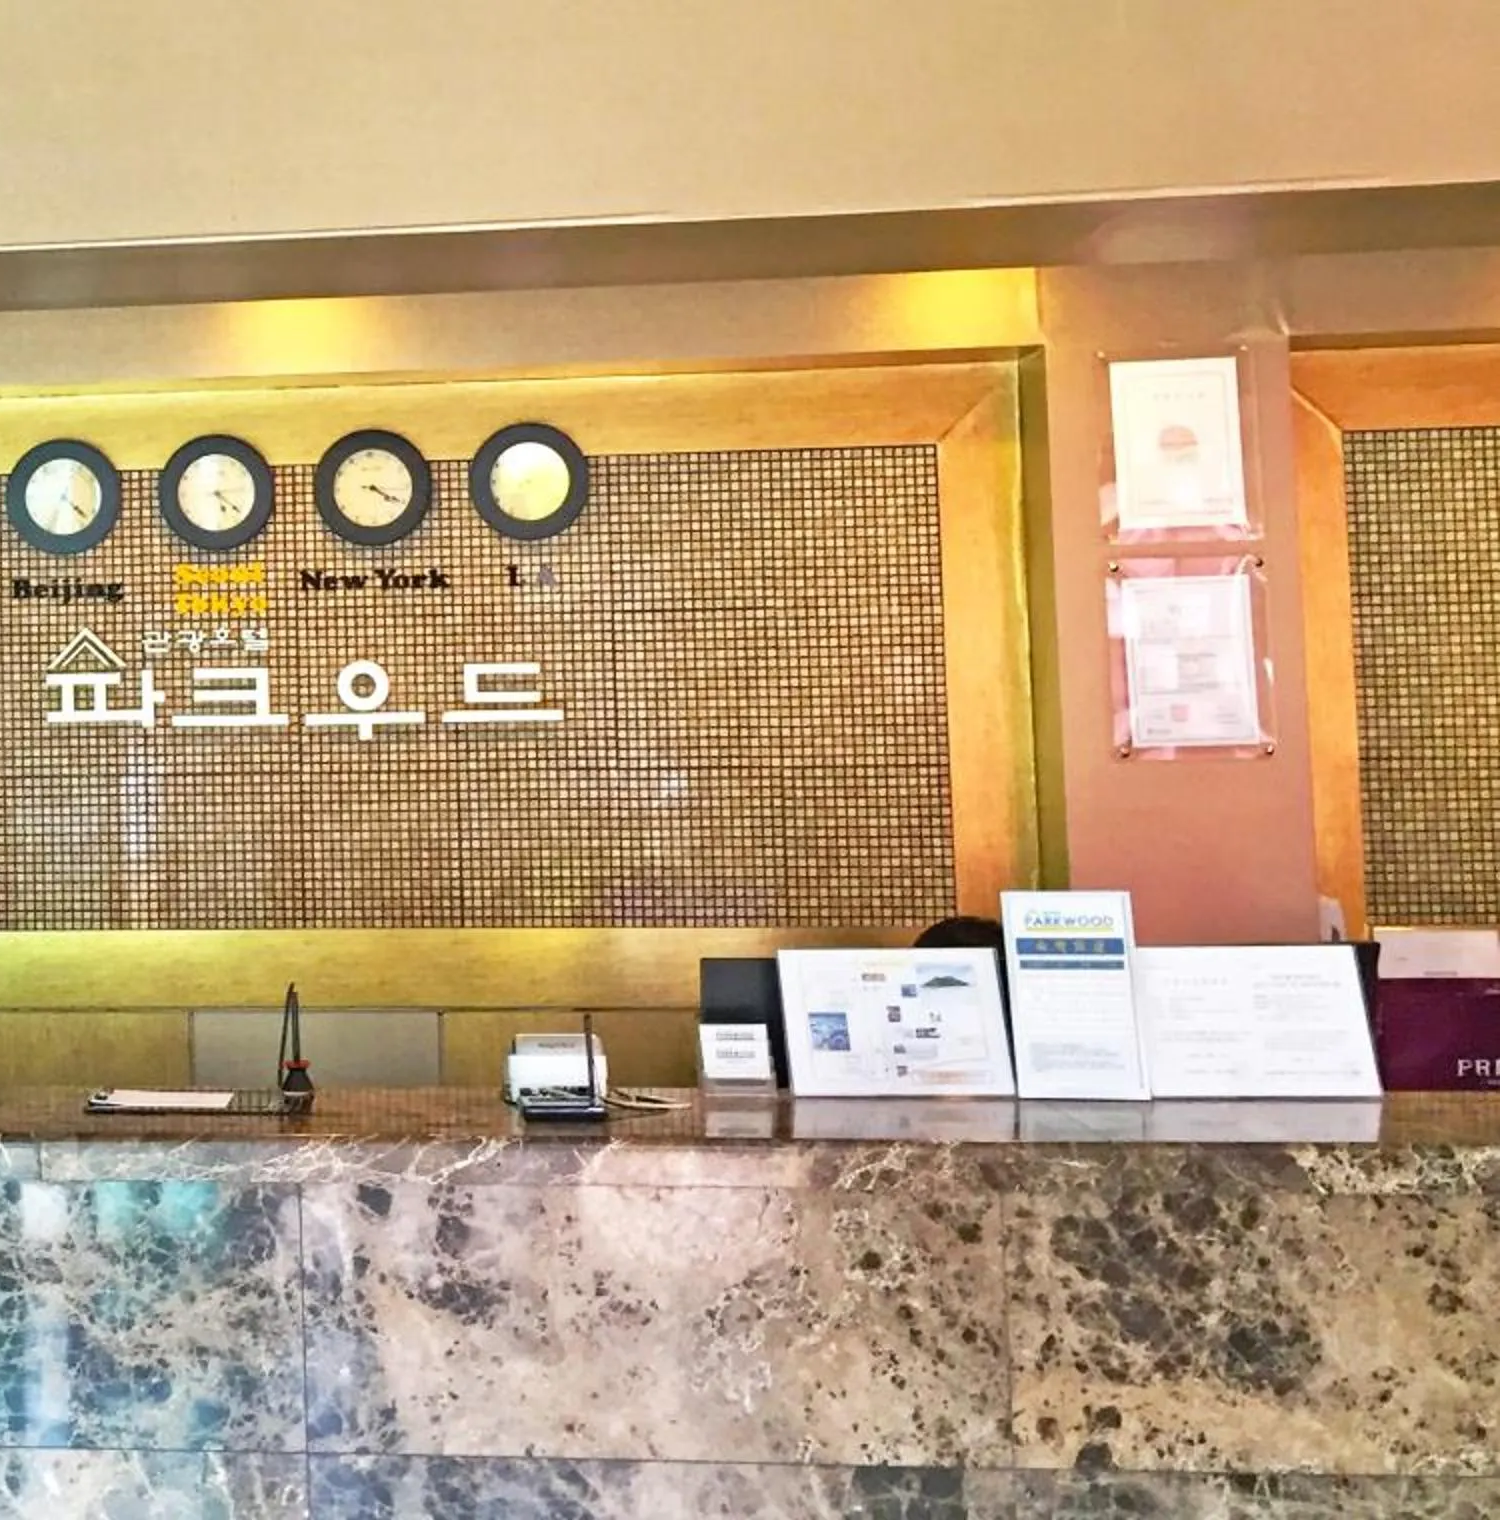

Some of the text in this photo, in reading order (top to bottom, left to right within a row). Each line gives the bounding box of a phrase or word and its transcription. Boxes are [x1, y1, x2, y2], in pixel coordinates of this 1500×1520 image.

[12, 578, 125, 604] Beijing
[299, 566, 452, 592] New York
[45, 650, 565, 741] 파크우드
